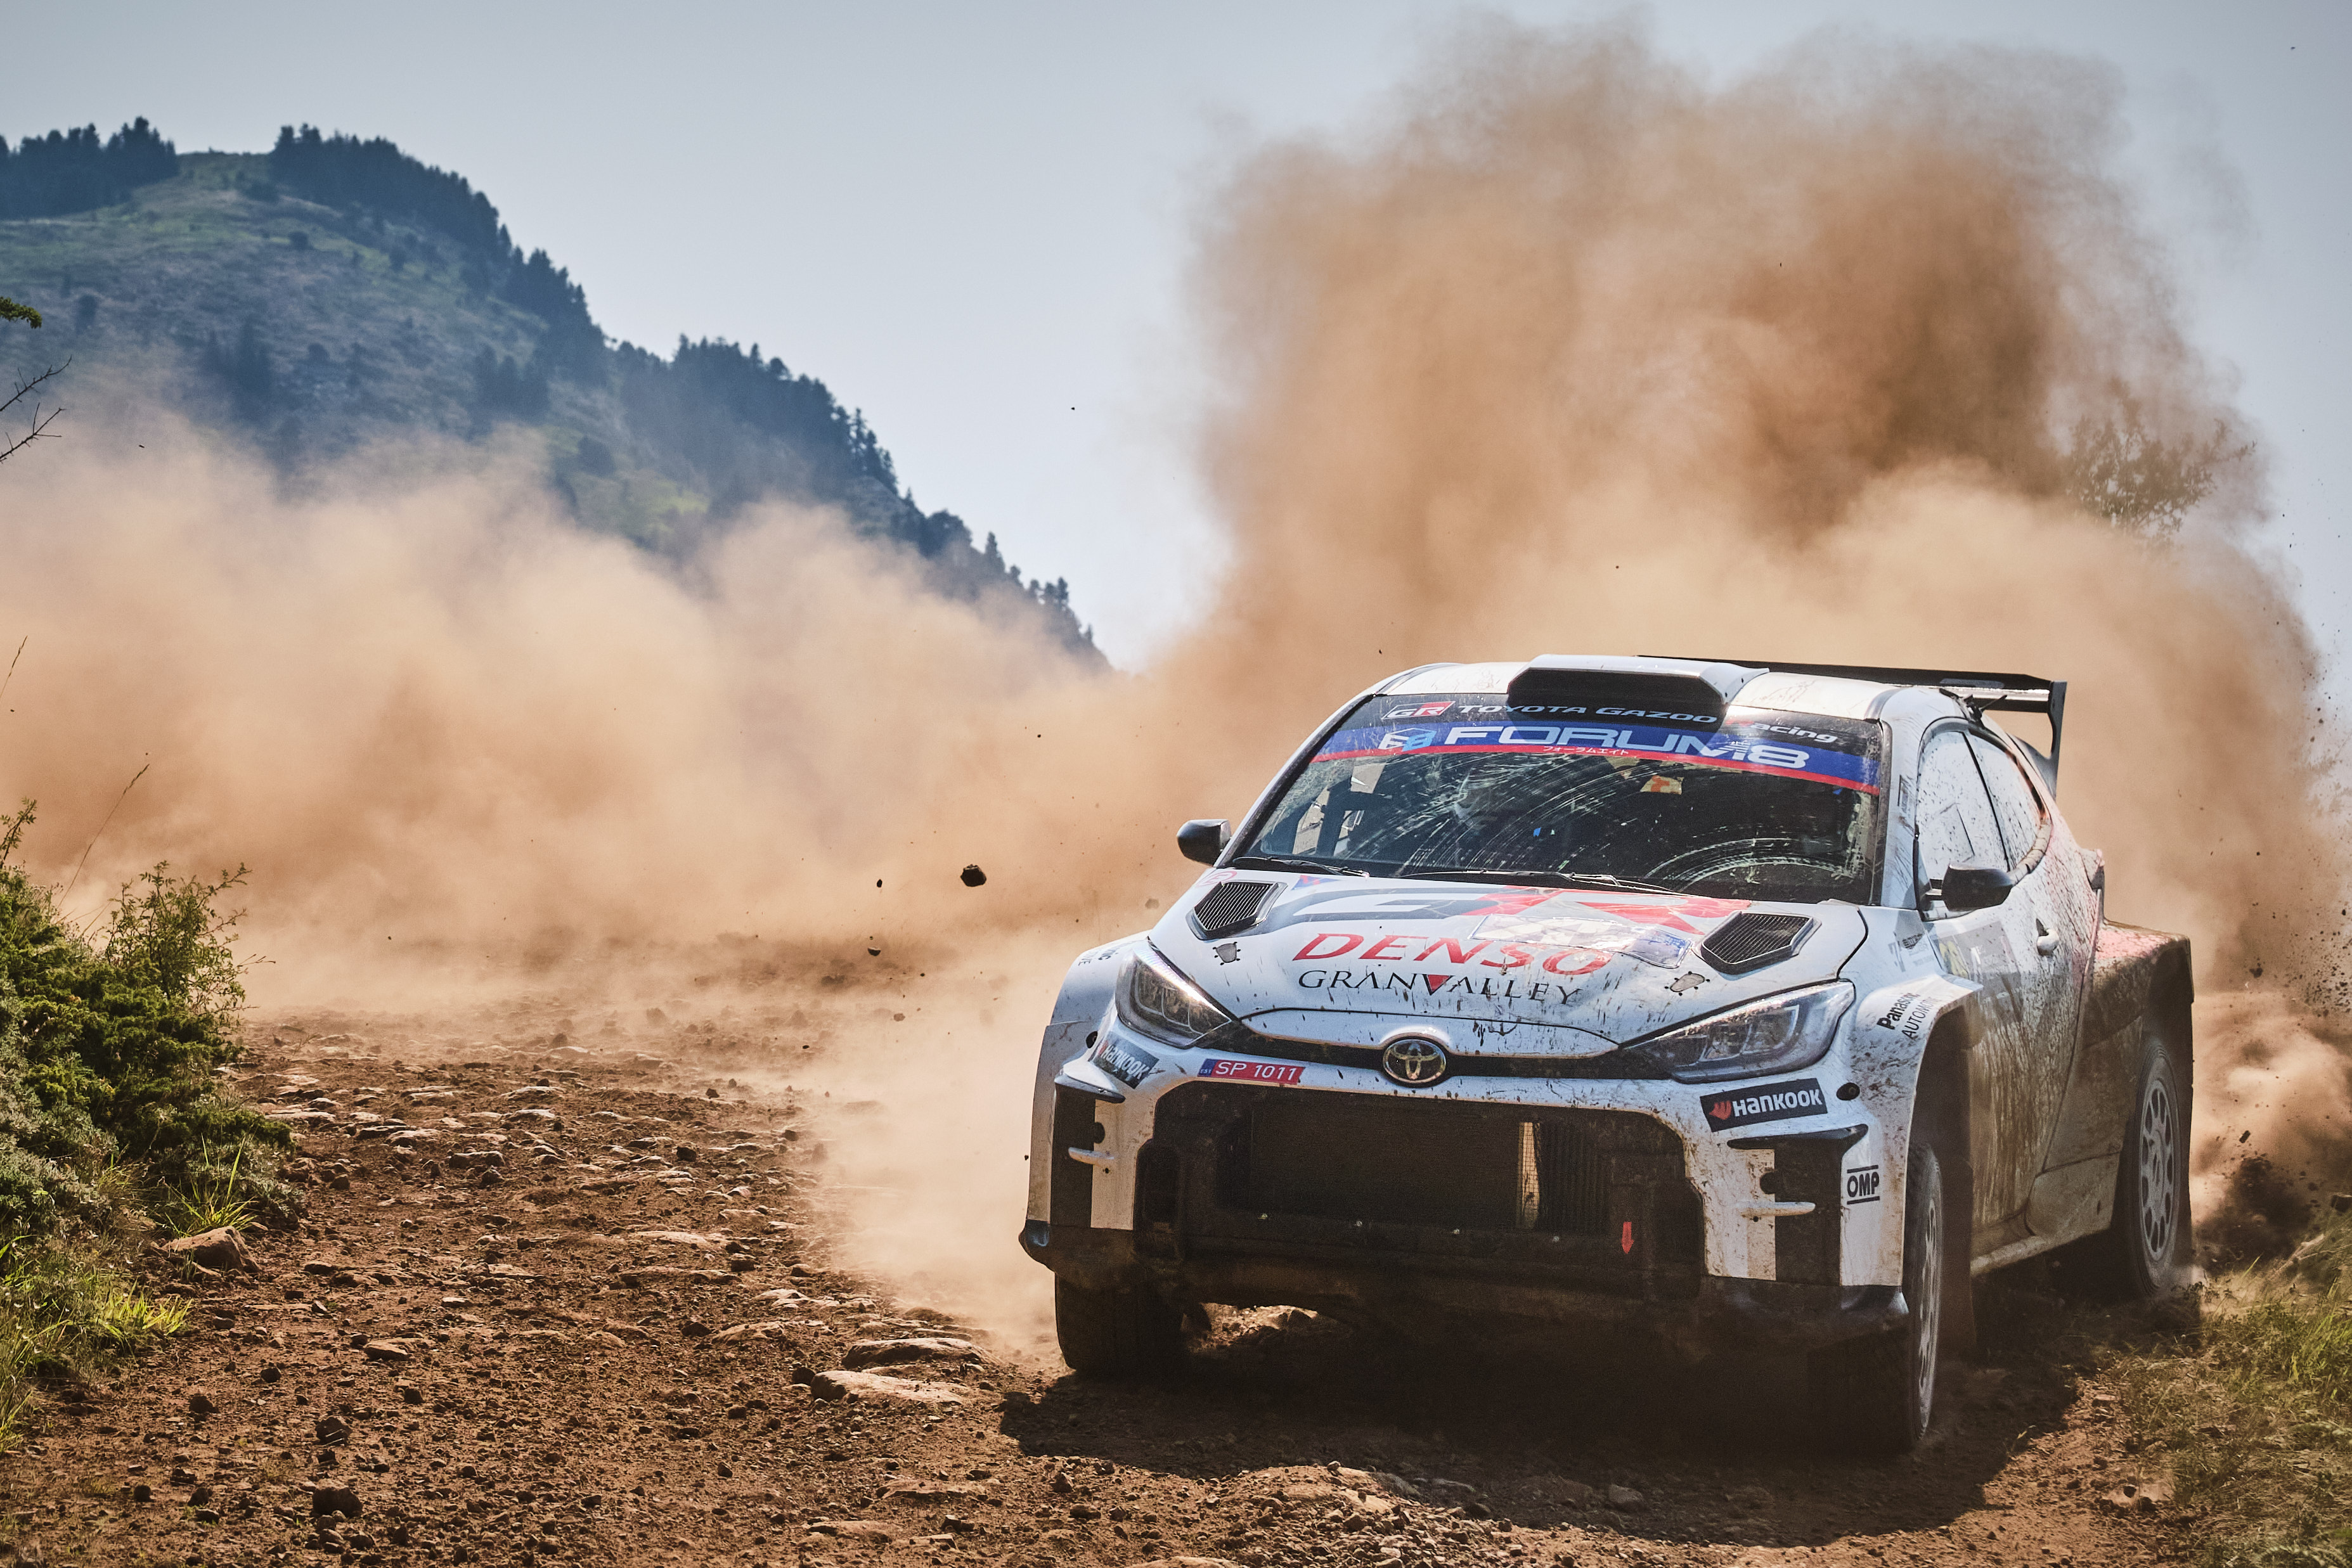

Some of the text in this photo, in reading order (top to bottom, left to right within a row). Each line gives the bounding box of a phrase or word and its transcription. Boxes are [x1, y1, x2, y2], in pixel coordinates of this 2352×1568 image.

[1459, 705, 1587, 714] TOYOTA
[1595, 707, 1717, 723] GAZOO
[1444, 726, 1810, 769] FORUM8
[1542, 745, 1629, 755] フォーラムエイト
[1292, 933, 1615, 975] DENSO
[1298, 970, 1583, 1005] GRANVALLEY
[1215, 1062, 1297, 1081] SP 1011
[1847, 1171, 1880, 1198] OMP
